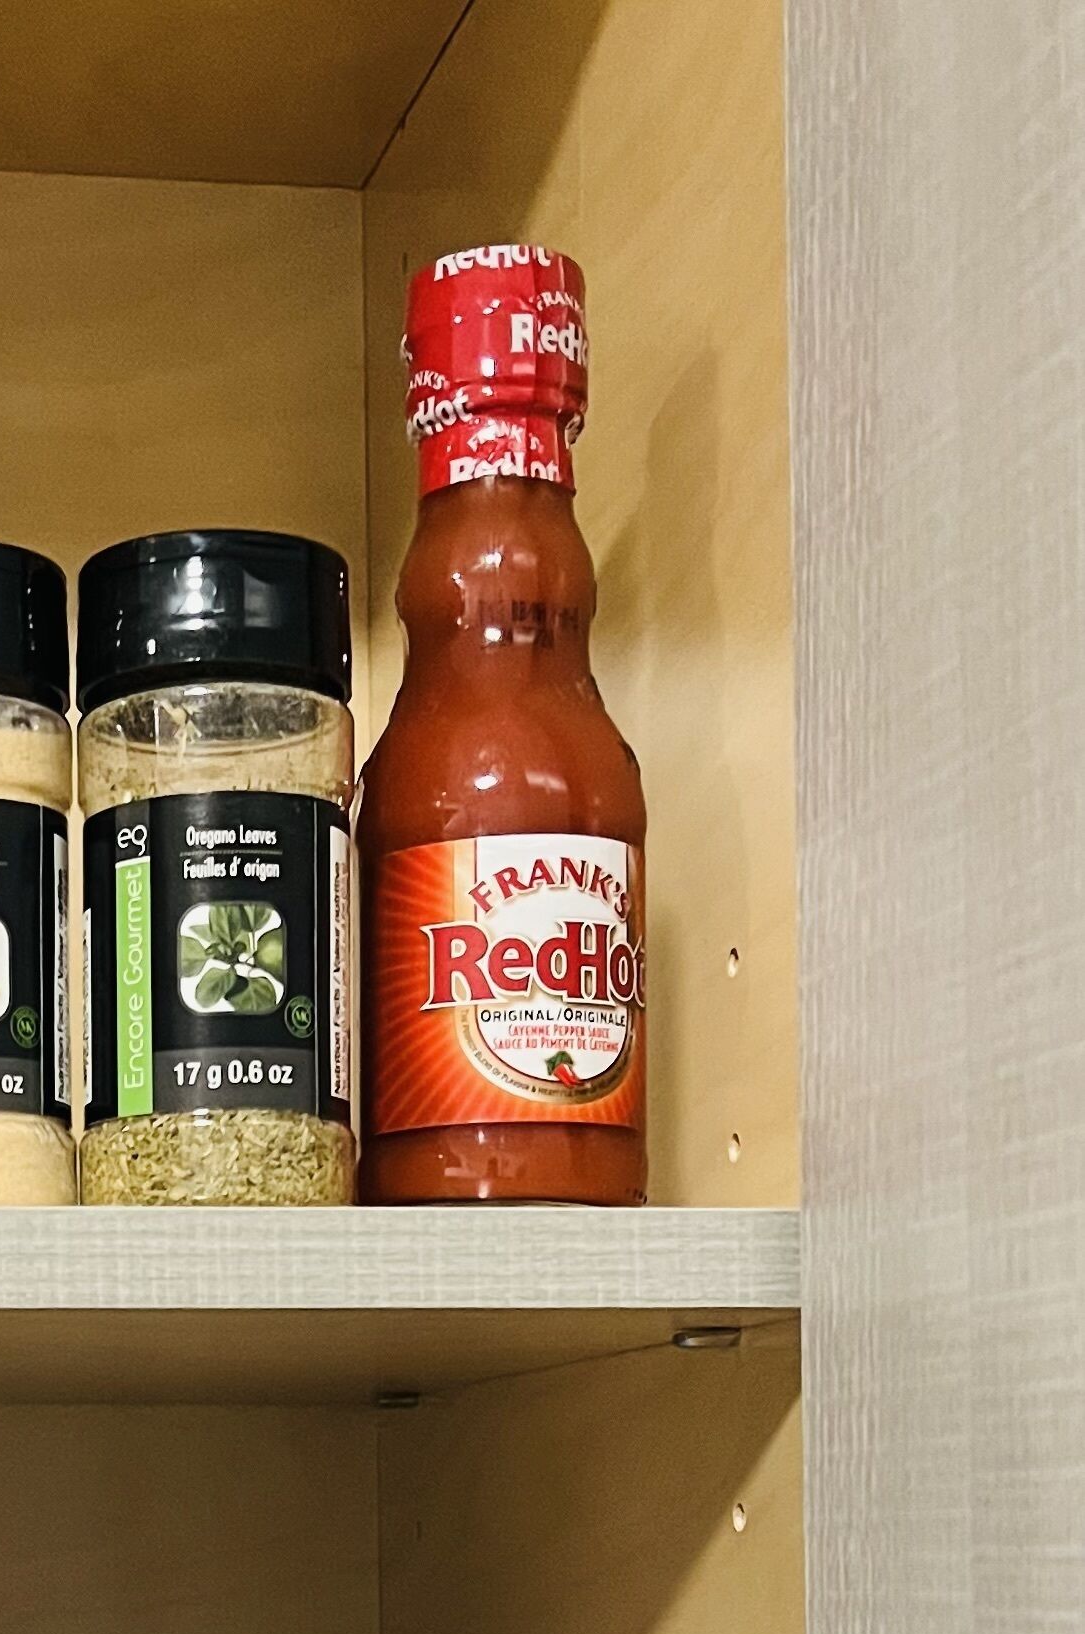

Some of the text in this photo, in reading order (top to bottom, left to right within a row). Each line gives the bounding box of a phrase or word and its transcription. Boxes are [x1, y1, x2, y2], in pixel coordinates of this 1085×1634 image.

[186, 824, 277, 848] Oregano Leaves
[183, 858, 227, 880] Feuilles
[244, 859, 280, 882] origan
[468, 857, 630, 921] FRANK'S
[123, 867, 145, 1089] Encore Gourmet
[2, 1074, 24, 1095] oz
[173, 1060, 293, 1089] 17 g 0.6 oz
